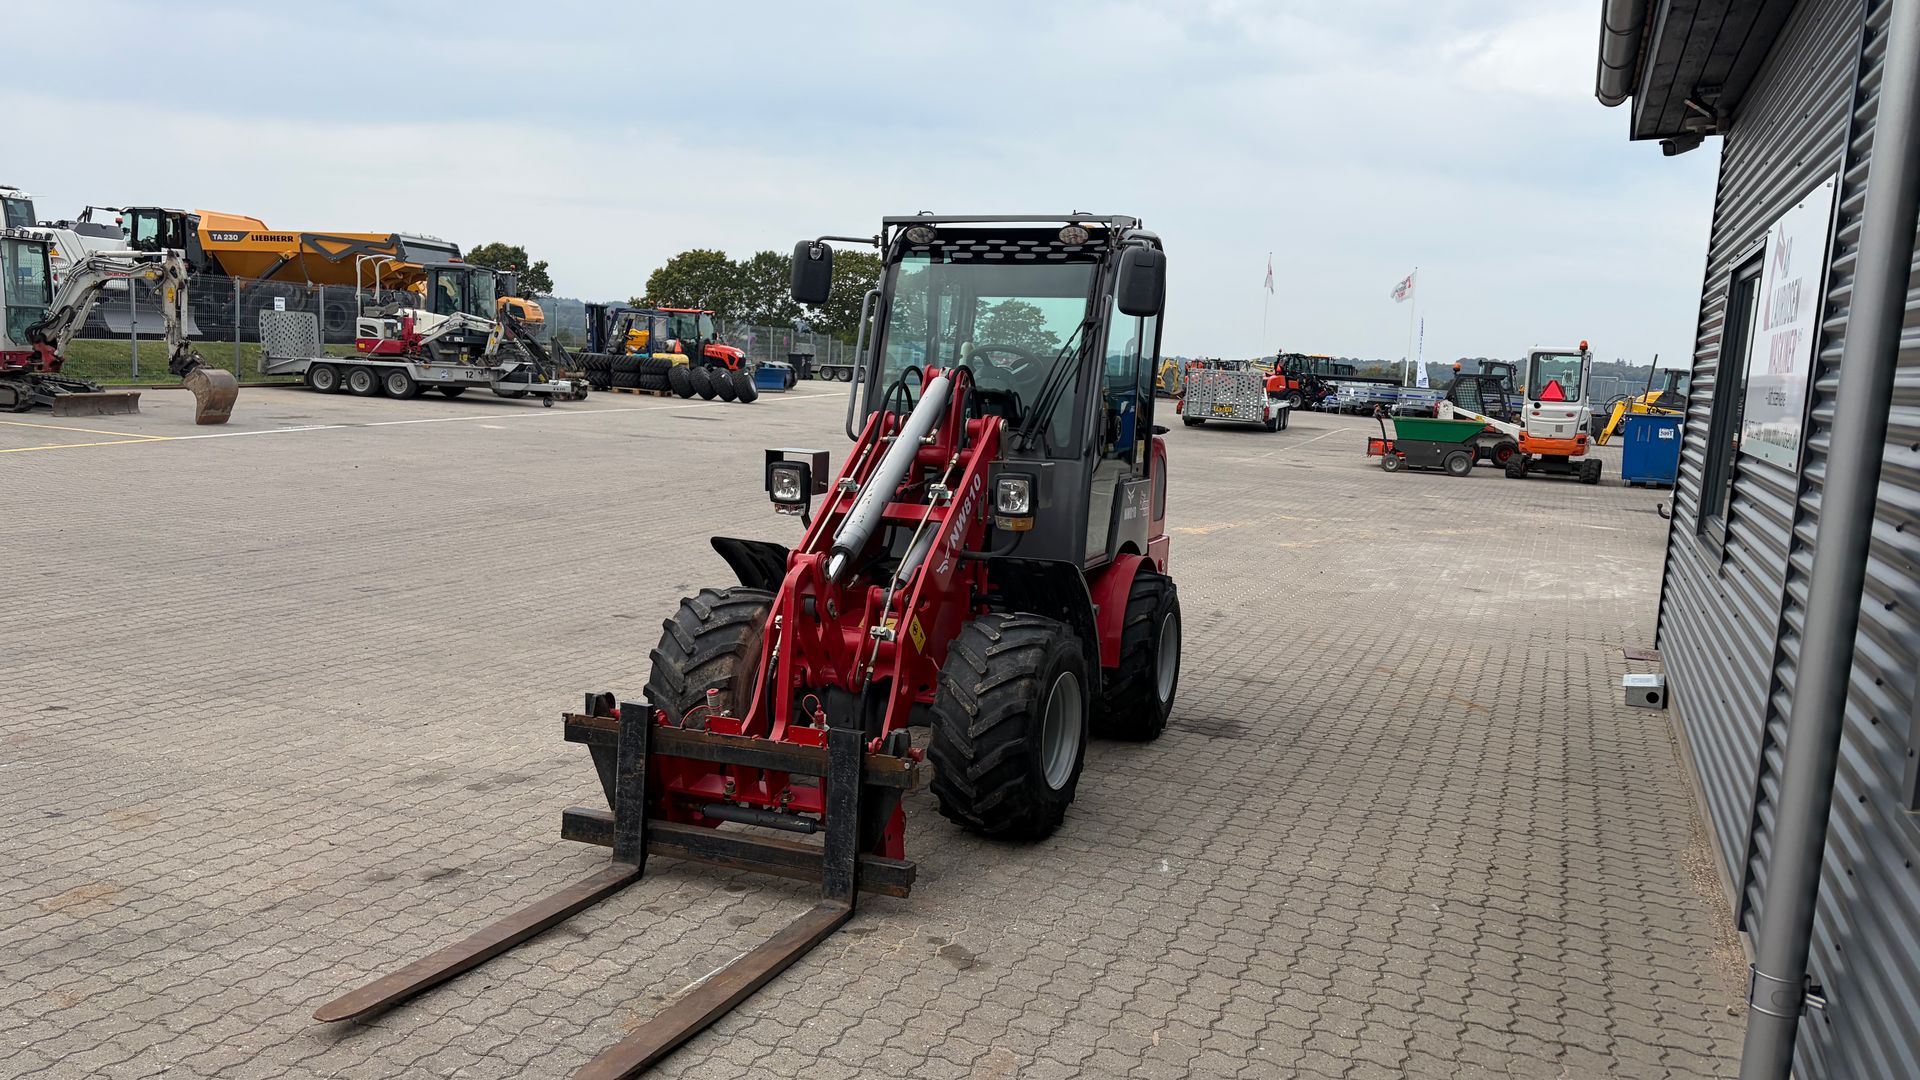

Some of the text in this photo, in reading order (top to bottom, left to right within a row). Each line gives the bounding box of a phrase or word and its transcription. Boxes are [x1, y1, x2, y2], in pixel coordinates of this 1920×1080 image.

[212, 233, 222, 241] TA
[251, 234, 294, 243] LIEBHERR
[465, 371, 474, 379] 12
[950, 473, 981, 549] NW810
